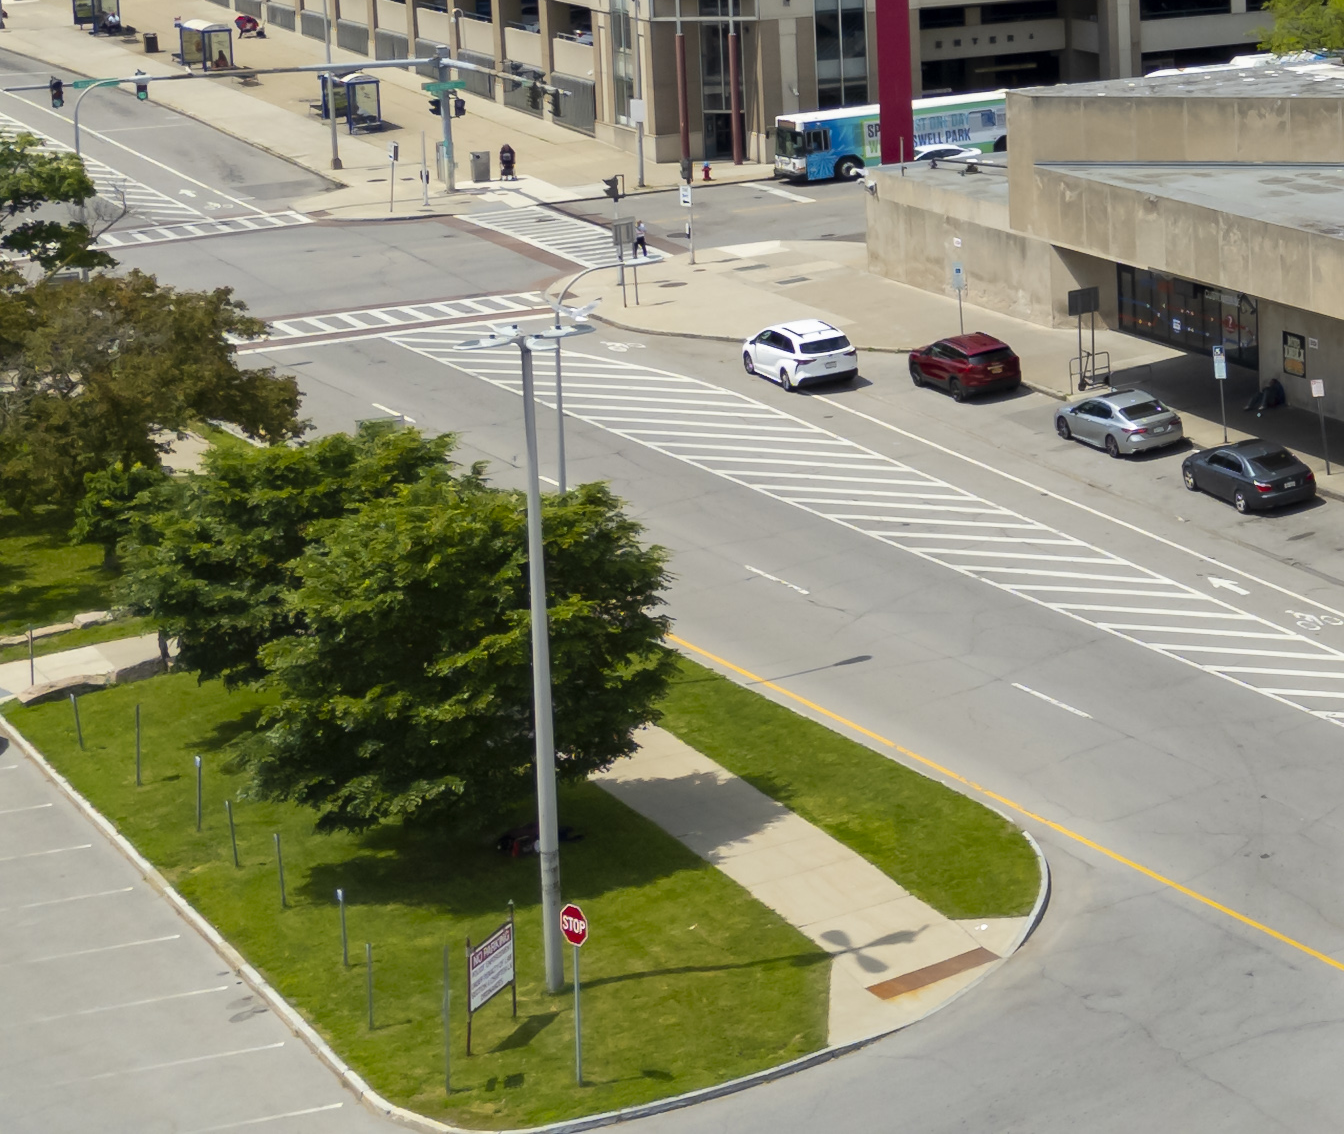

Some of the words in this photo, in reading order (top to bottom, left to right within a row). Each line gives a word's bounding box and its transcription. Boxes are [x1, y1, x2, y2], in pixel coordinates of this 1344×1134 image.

[929, 116, 947, 129] ONE
[951, 113, 969, 127] DAY
[946, 127, 971, 143] PARK
[562, 914, 586, 935] STOP
[483, 928, 511, 959] PARKING
